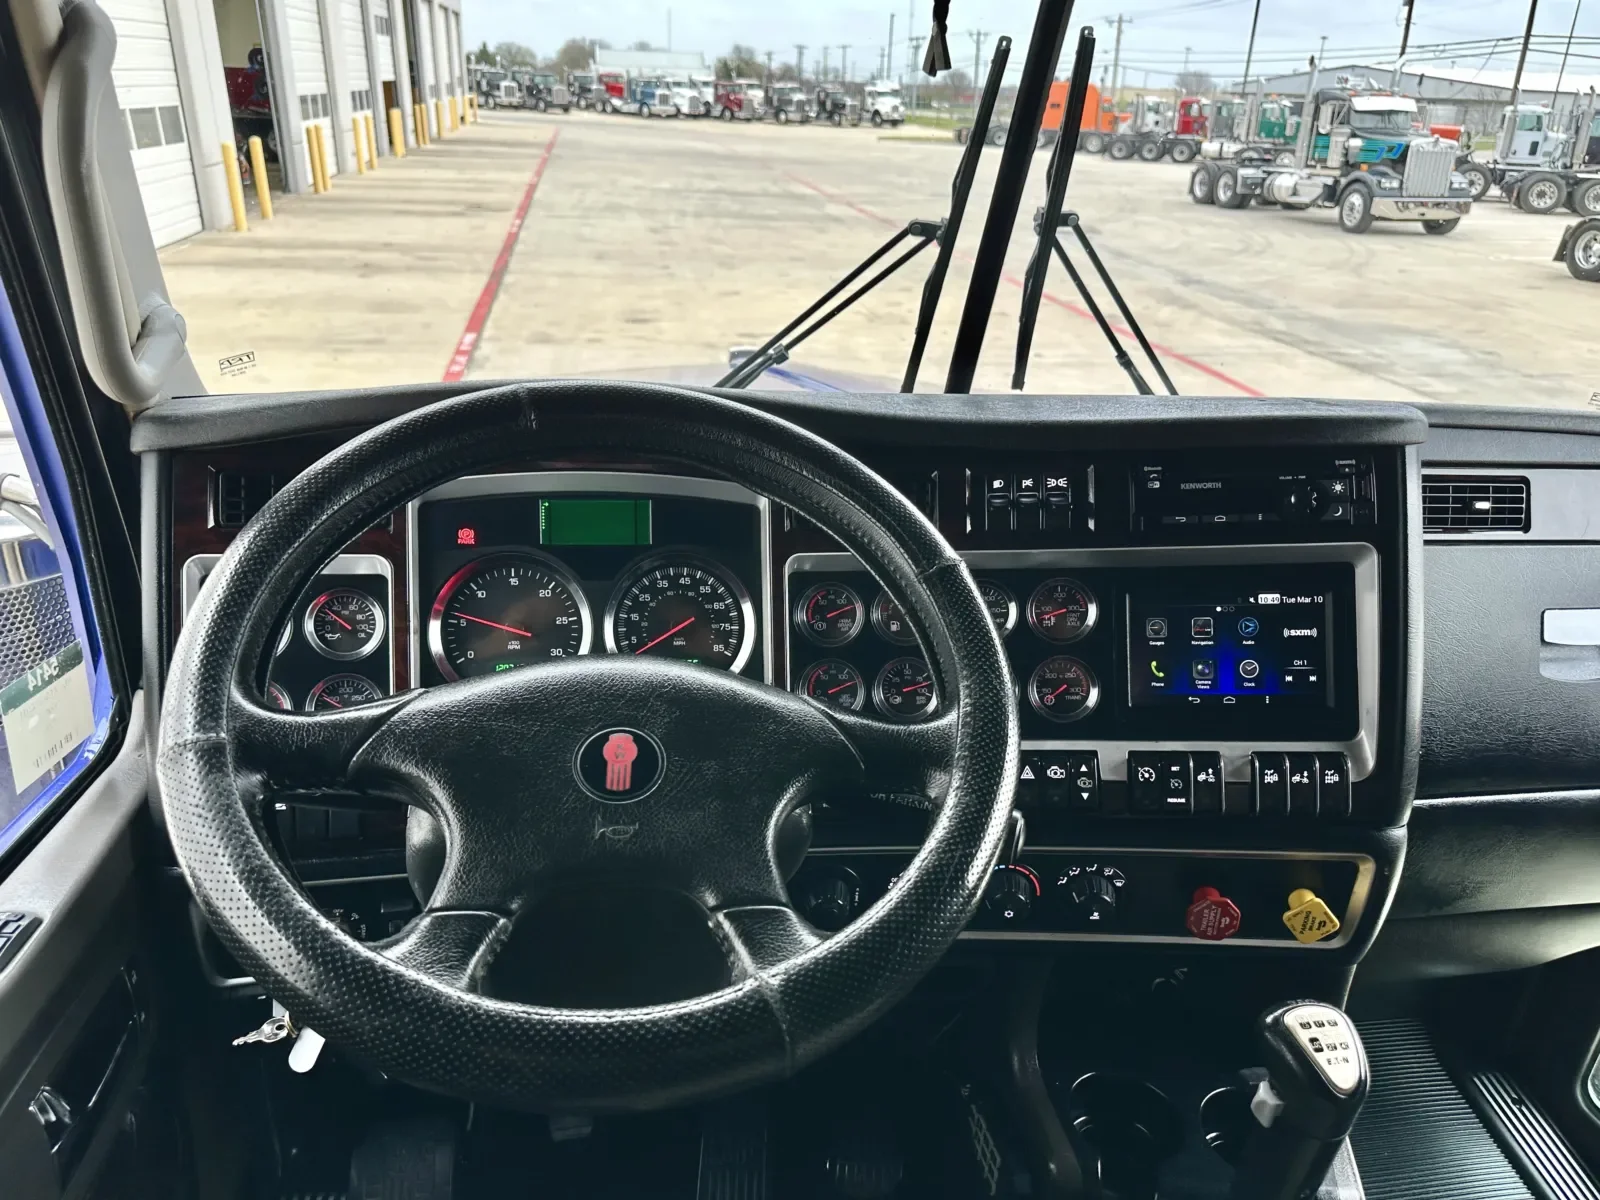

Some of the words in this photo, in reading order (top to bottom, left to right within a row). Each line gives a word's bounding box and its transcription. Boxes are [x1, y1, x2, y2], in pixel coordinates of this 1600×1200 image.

[1180, 482, 1222, 490] KENWORTH
[508, 578, 519, 586] 15
[679, 577, 690, 585] 45
[476, 590, 486, 598] 10
[1259, 596, 1280, 604] 10:49
[629, 613, 639, 621] 15
[460, 619, 467, 627] 5
[631, 636, 637, 644] 5
[467, 651, 474, 659] 0
[550, 648, 563, 656] 30
[1200, 908, 1210, 931] TRAILER
[1208, 905, 1217, 926] SUPPLY
[1299, 910, 1312, 935] PARKING
[1308, 916, 1317, 931] BRAKE
